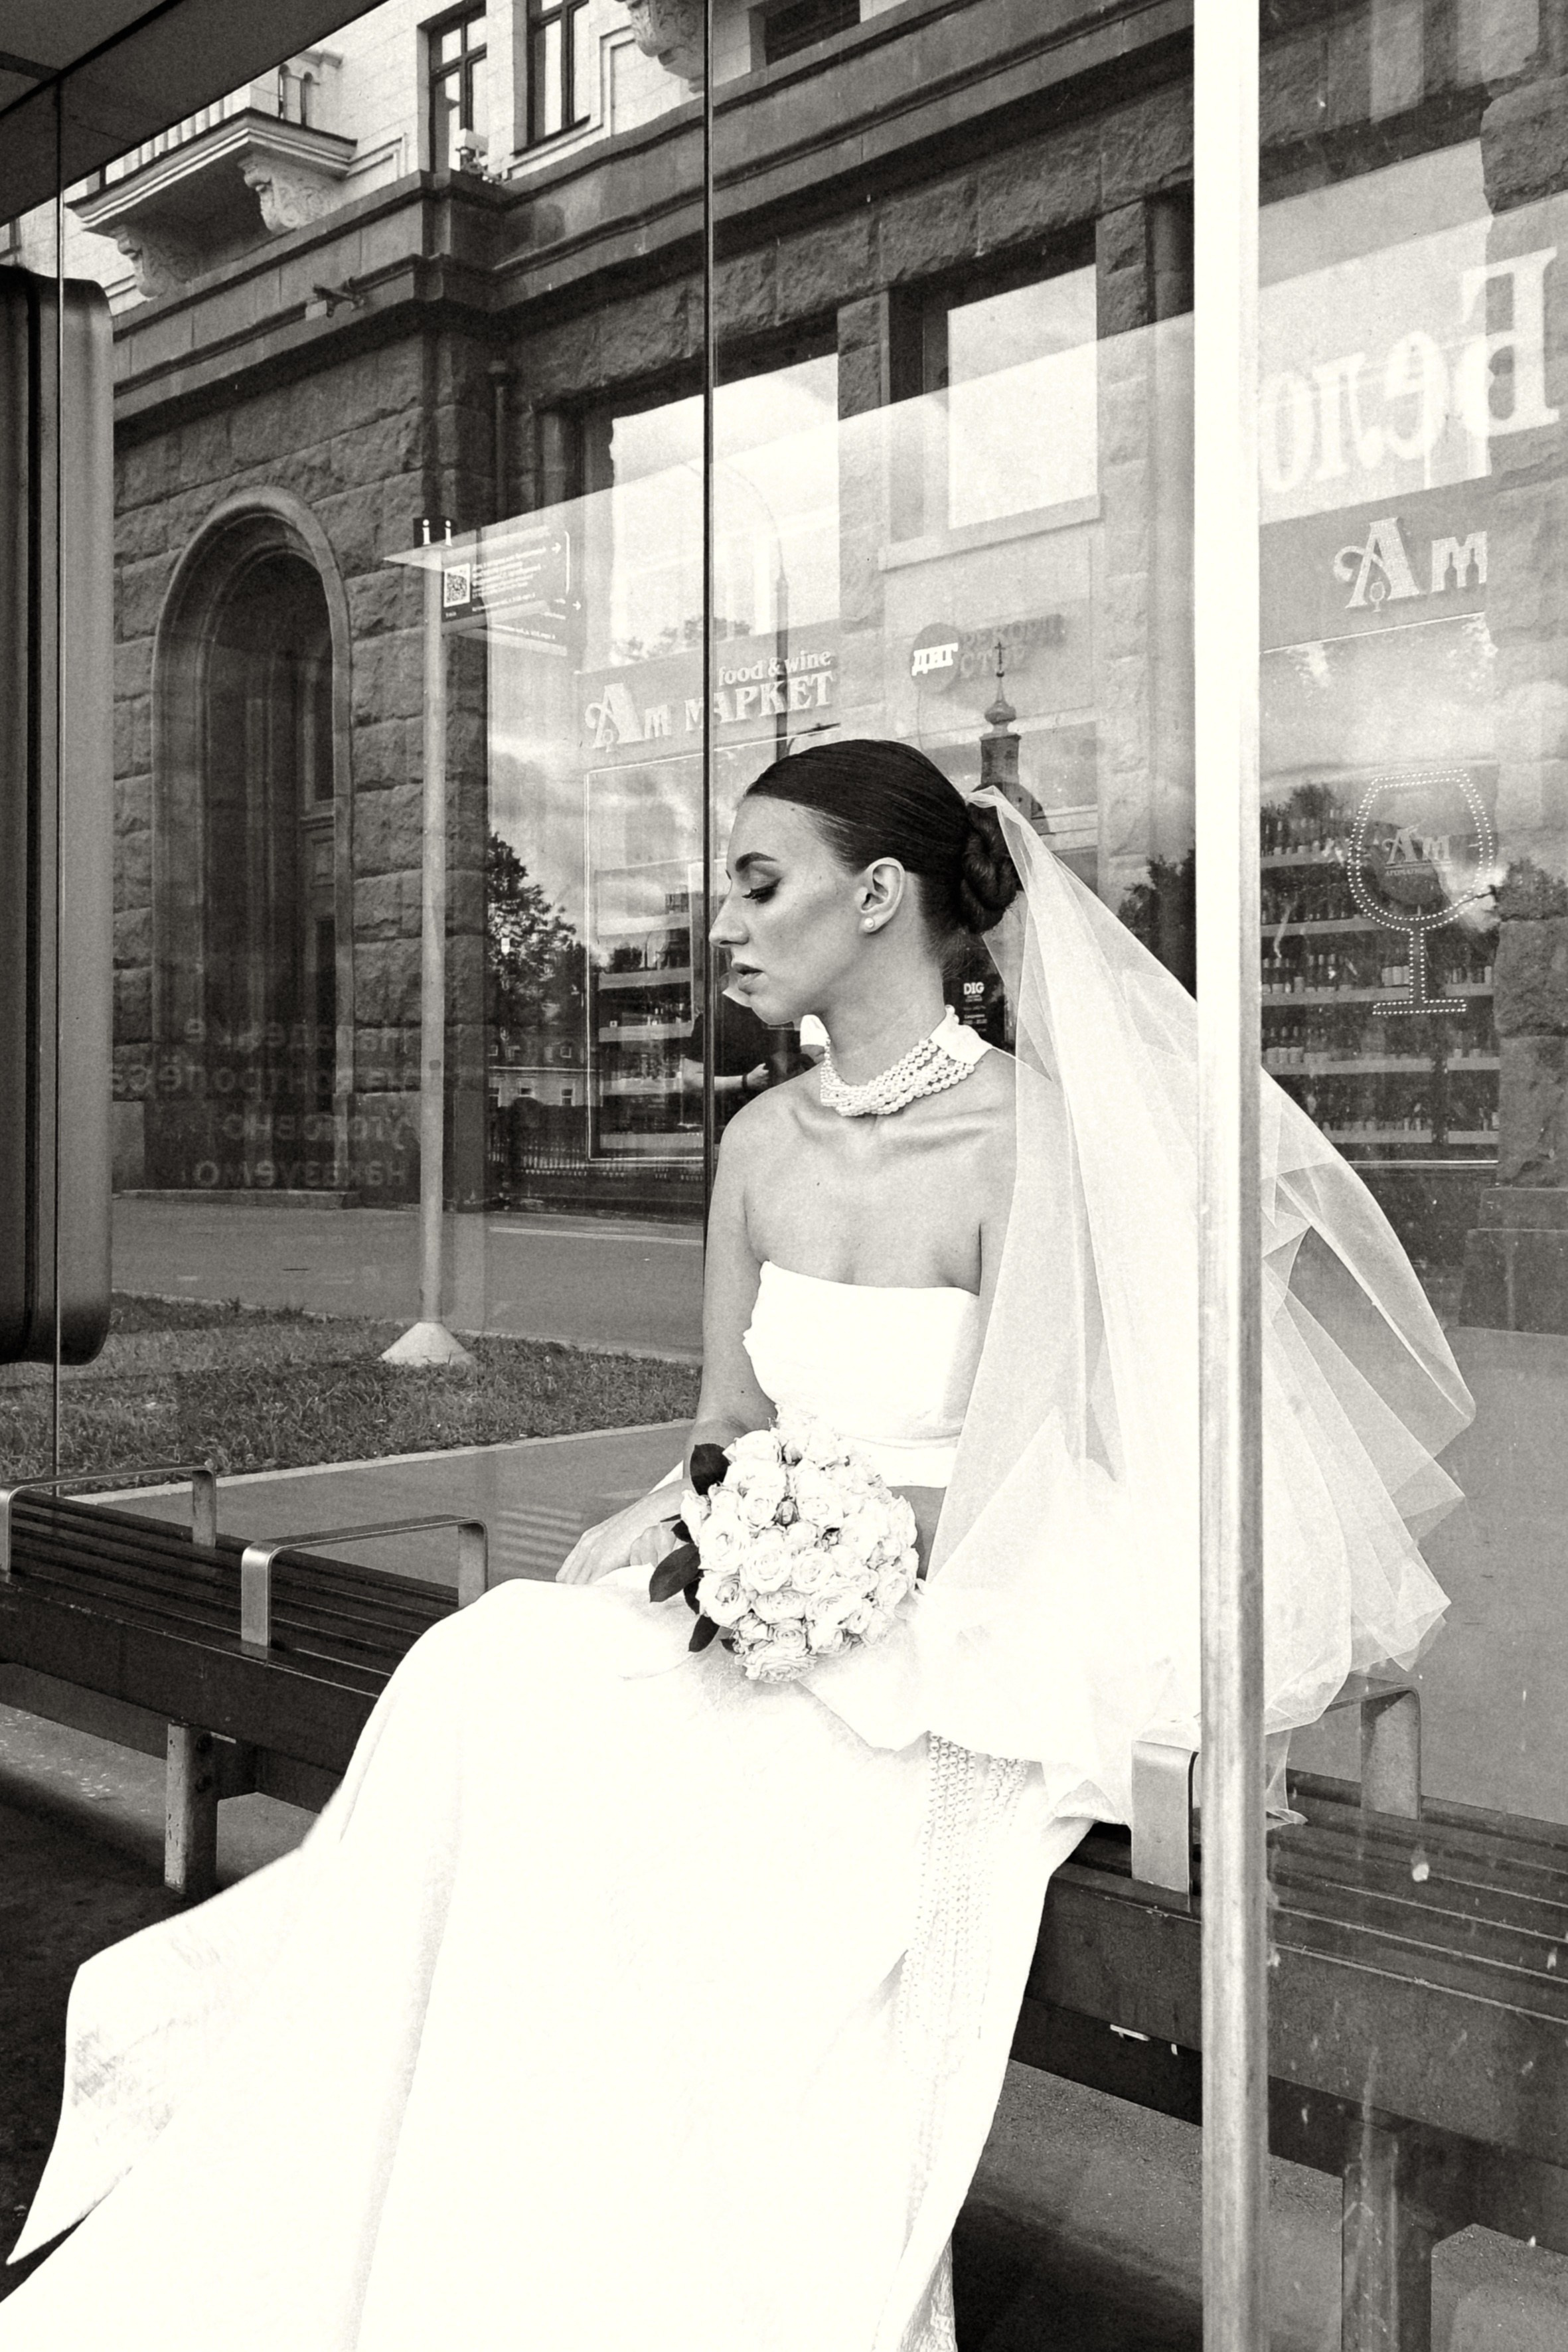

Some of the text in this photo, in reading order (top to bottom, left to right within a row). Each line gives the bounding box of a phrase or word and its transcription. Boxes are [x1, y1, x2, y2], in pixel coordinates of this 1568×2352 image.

[719, 651, 831, 686] food & wine
[963, 981, 984, 995] DIG
